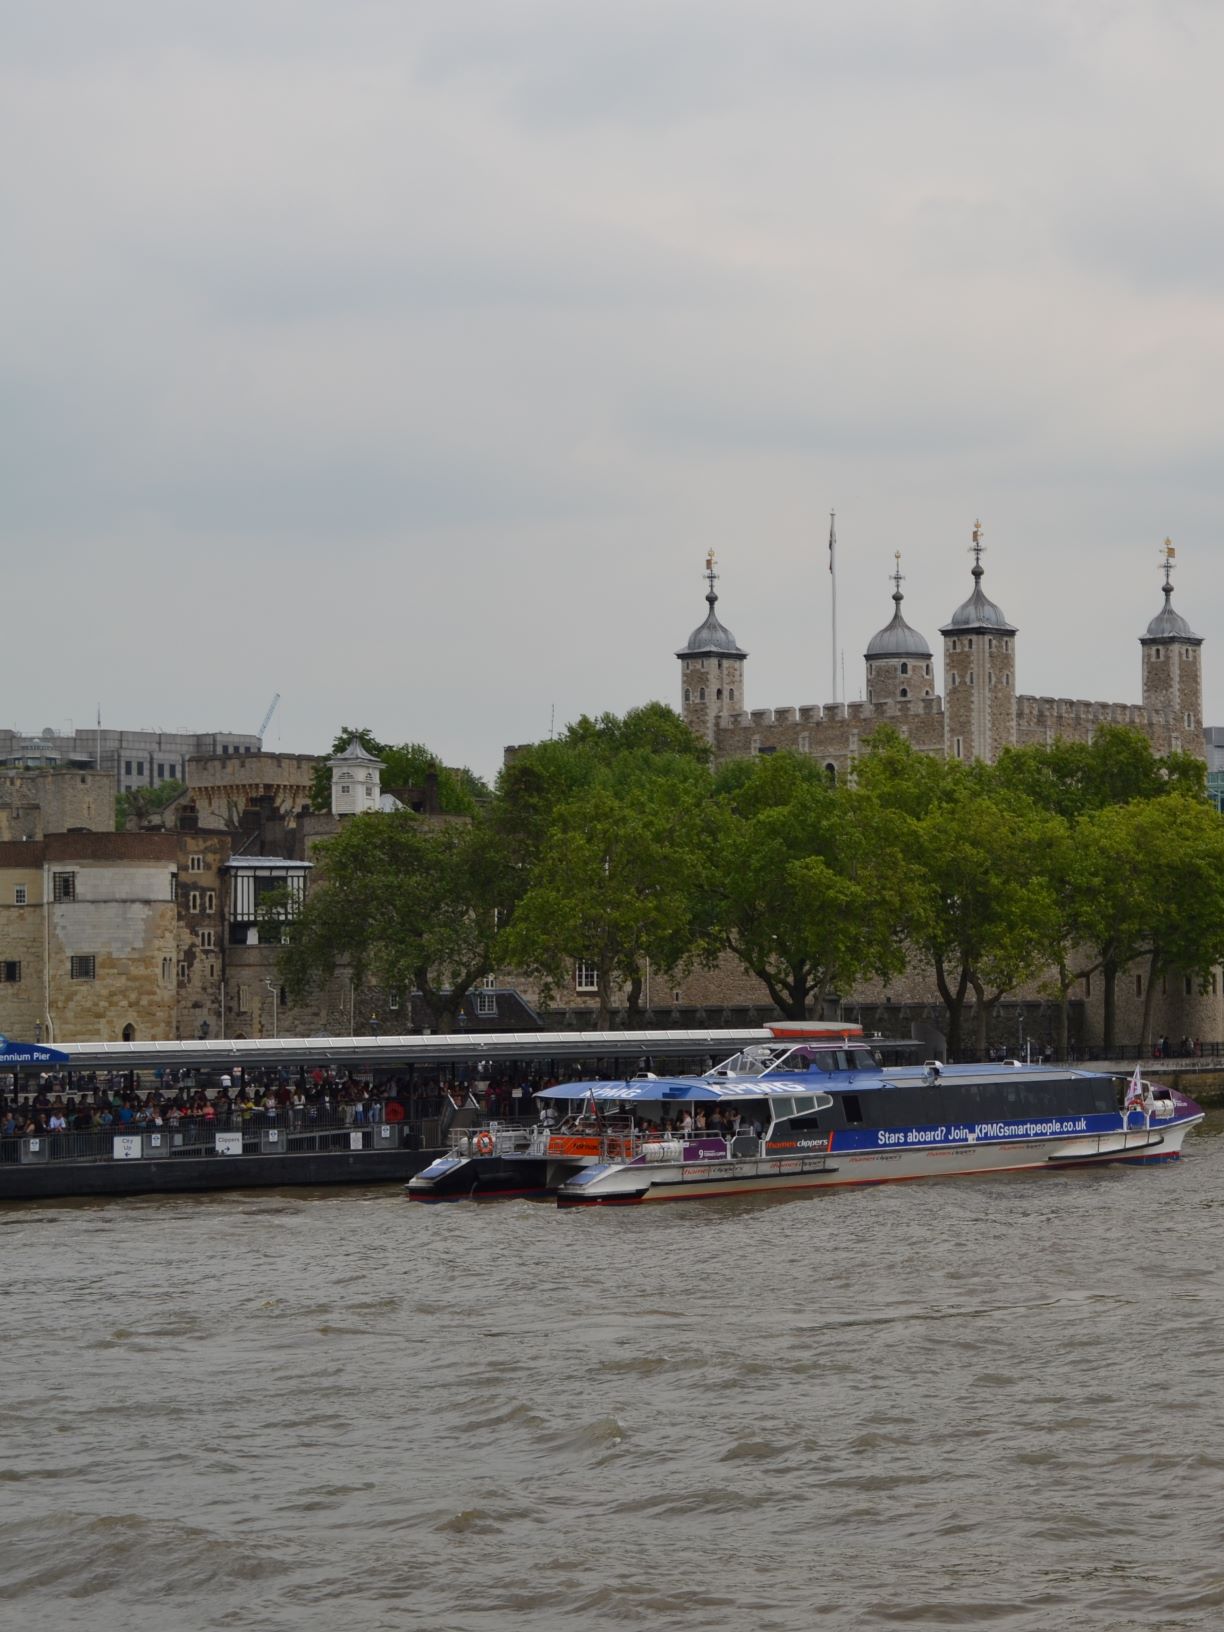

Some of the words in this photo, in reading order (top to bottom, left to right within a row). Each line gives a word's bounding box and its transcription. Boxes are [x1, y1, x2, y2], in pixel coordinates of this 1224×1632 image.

[33, 1052, 50, 1060] Pier
[579, 1088, 642, 1098] KPMG
[702, 1081, 806, 1095] KPMG
[877, 1130, 905, 1145] Stars
[907, 1127, 946, 1143] aboard?
[948, 1126, 969, 1140] Join
[975, 1117, 1087, 1138] KPMGsmartpeople.co.uk
[698, 1149, 704, 1159] 9
